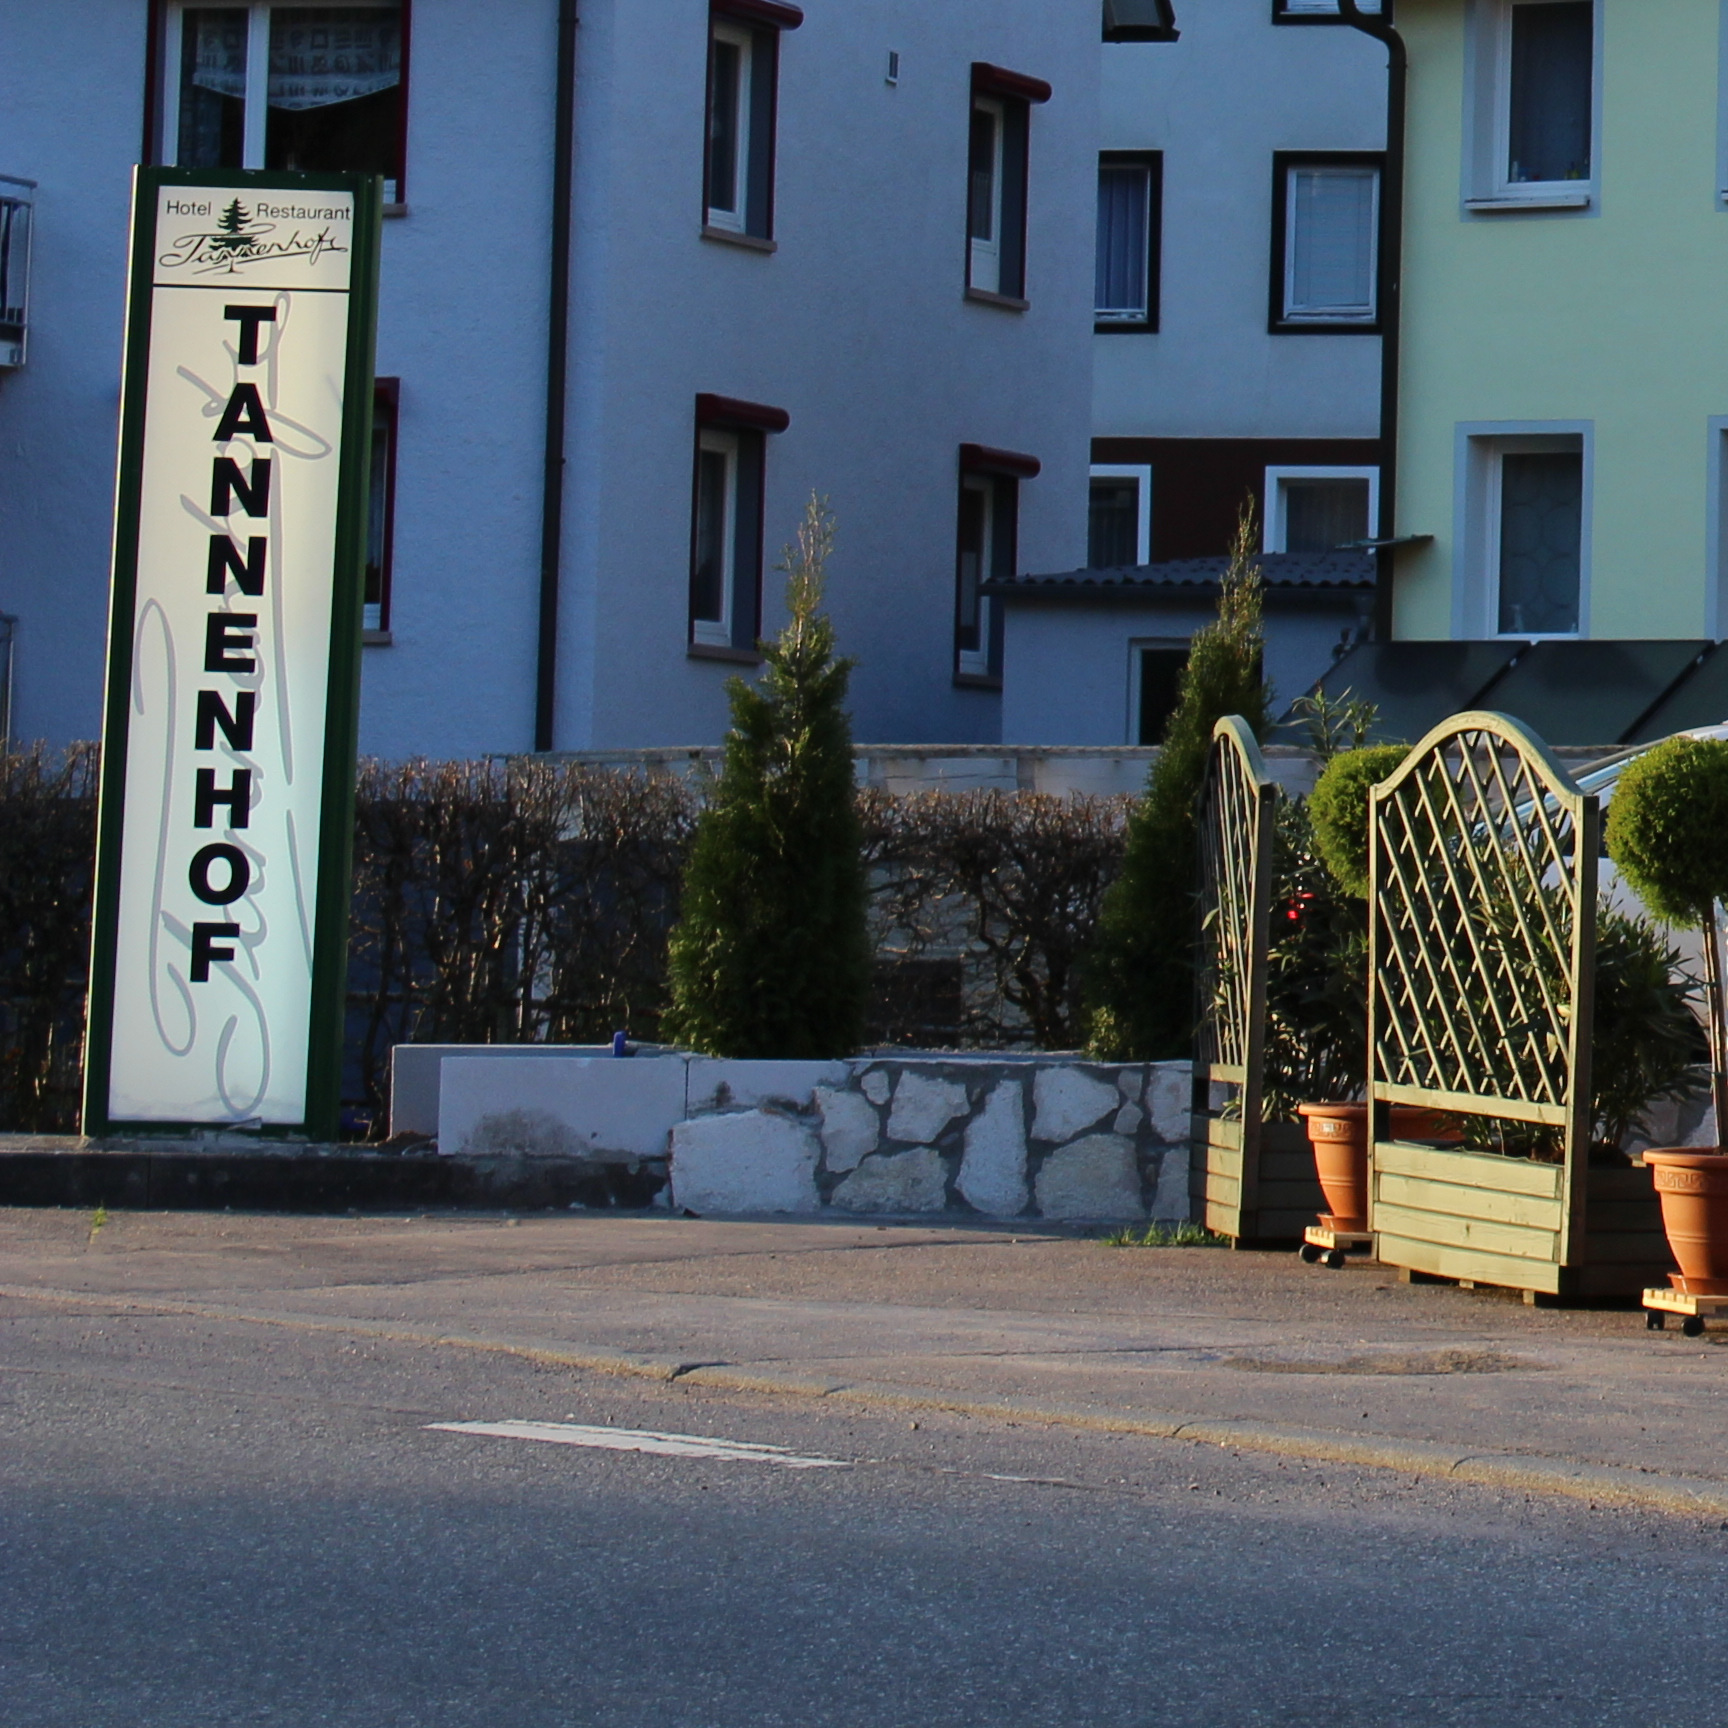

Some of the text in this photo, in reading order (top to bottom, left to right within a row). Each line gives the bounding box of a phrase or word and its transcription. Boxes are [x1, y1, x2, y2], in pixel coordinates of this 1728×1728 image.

[166, 200, 351, 221] Hotel Restaurant
[189, 304, 278, 983] TANNENHOF
